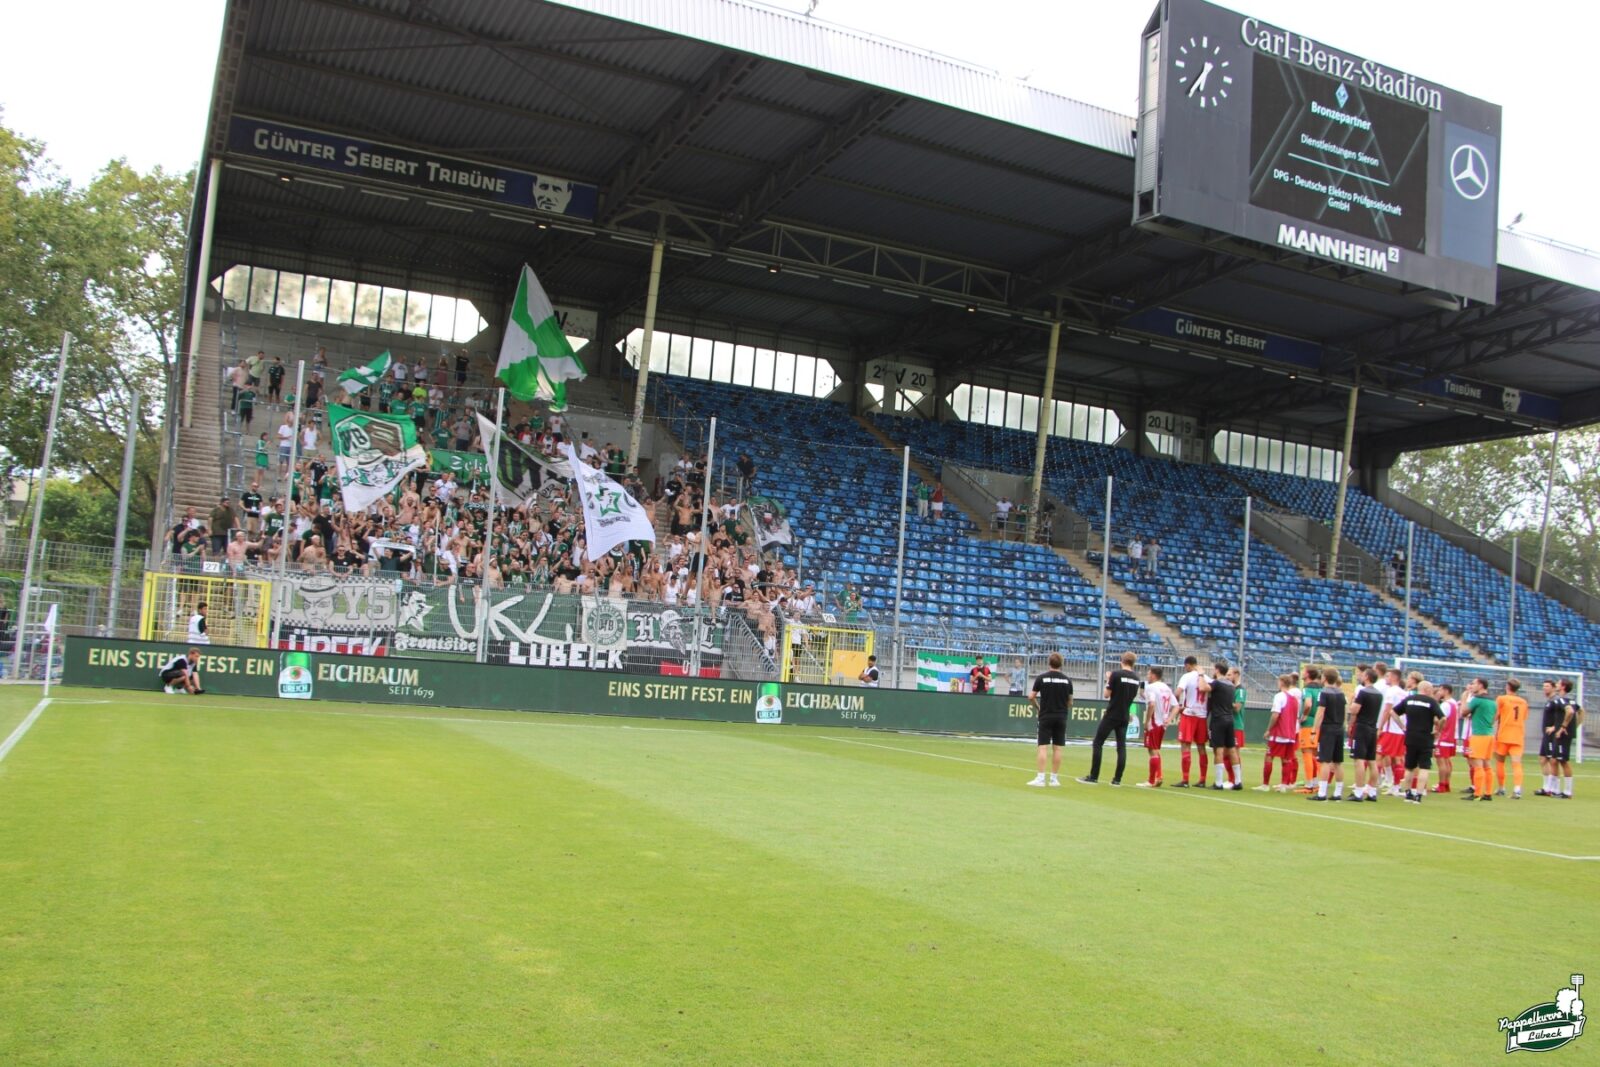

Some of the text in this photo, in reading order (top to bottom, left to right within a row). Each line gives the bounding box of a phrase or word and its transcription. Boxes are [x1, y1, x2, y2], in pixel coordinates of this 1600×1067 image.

[1241, 17, 1443, 111] Carl-Benz-Stadion
[1311, 101, 1371, 130] Bronzepartner
[1301, 133, 1356, 159] Dienstleistungen
[344, 145, 419, 176] SEBERT
[426, 161, 507, 193] TRIBÜNE
[1274, 168, 1289, 181] DPG
[1295, 174, 1327, 194] Deutsche
[1328, 185, 1352, 201] Elektro
[1328, 197, 1350, 212] GmbH
[1277, 224, 1387, 272] MANNHEIM
[1175, 318, 1267, 351] GÜNTER SEBERT
[911, 372, 926, 387] 20
[1148, 415, 1161, 429] 20
[88, 648, 130, 667] EINS
[246, 658, 274, 676] EIN
[318, 663, 419, 686] EICHBAUM
[388, 686, 434, 699] SEIT 1679
[608, 681, 752, 704] EINS STEHT FEST. EIN
[786, 692, 865, 711] EICHBAUM
[841, 711, 876, 722] SEIT 1679
[1008, 704, 1033, 718] EINS
[1072, 707, 1098, 721] FEST.
[1513, 706, 1519, 720] 1
